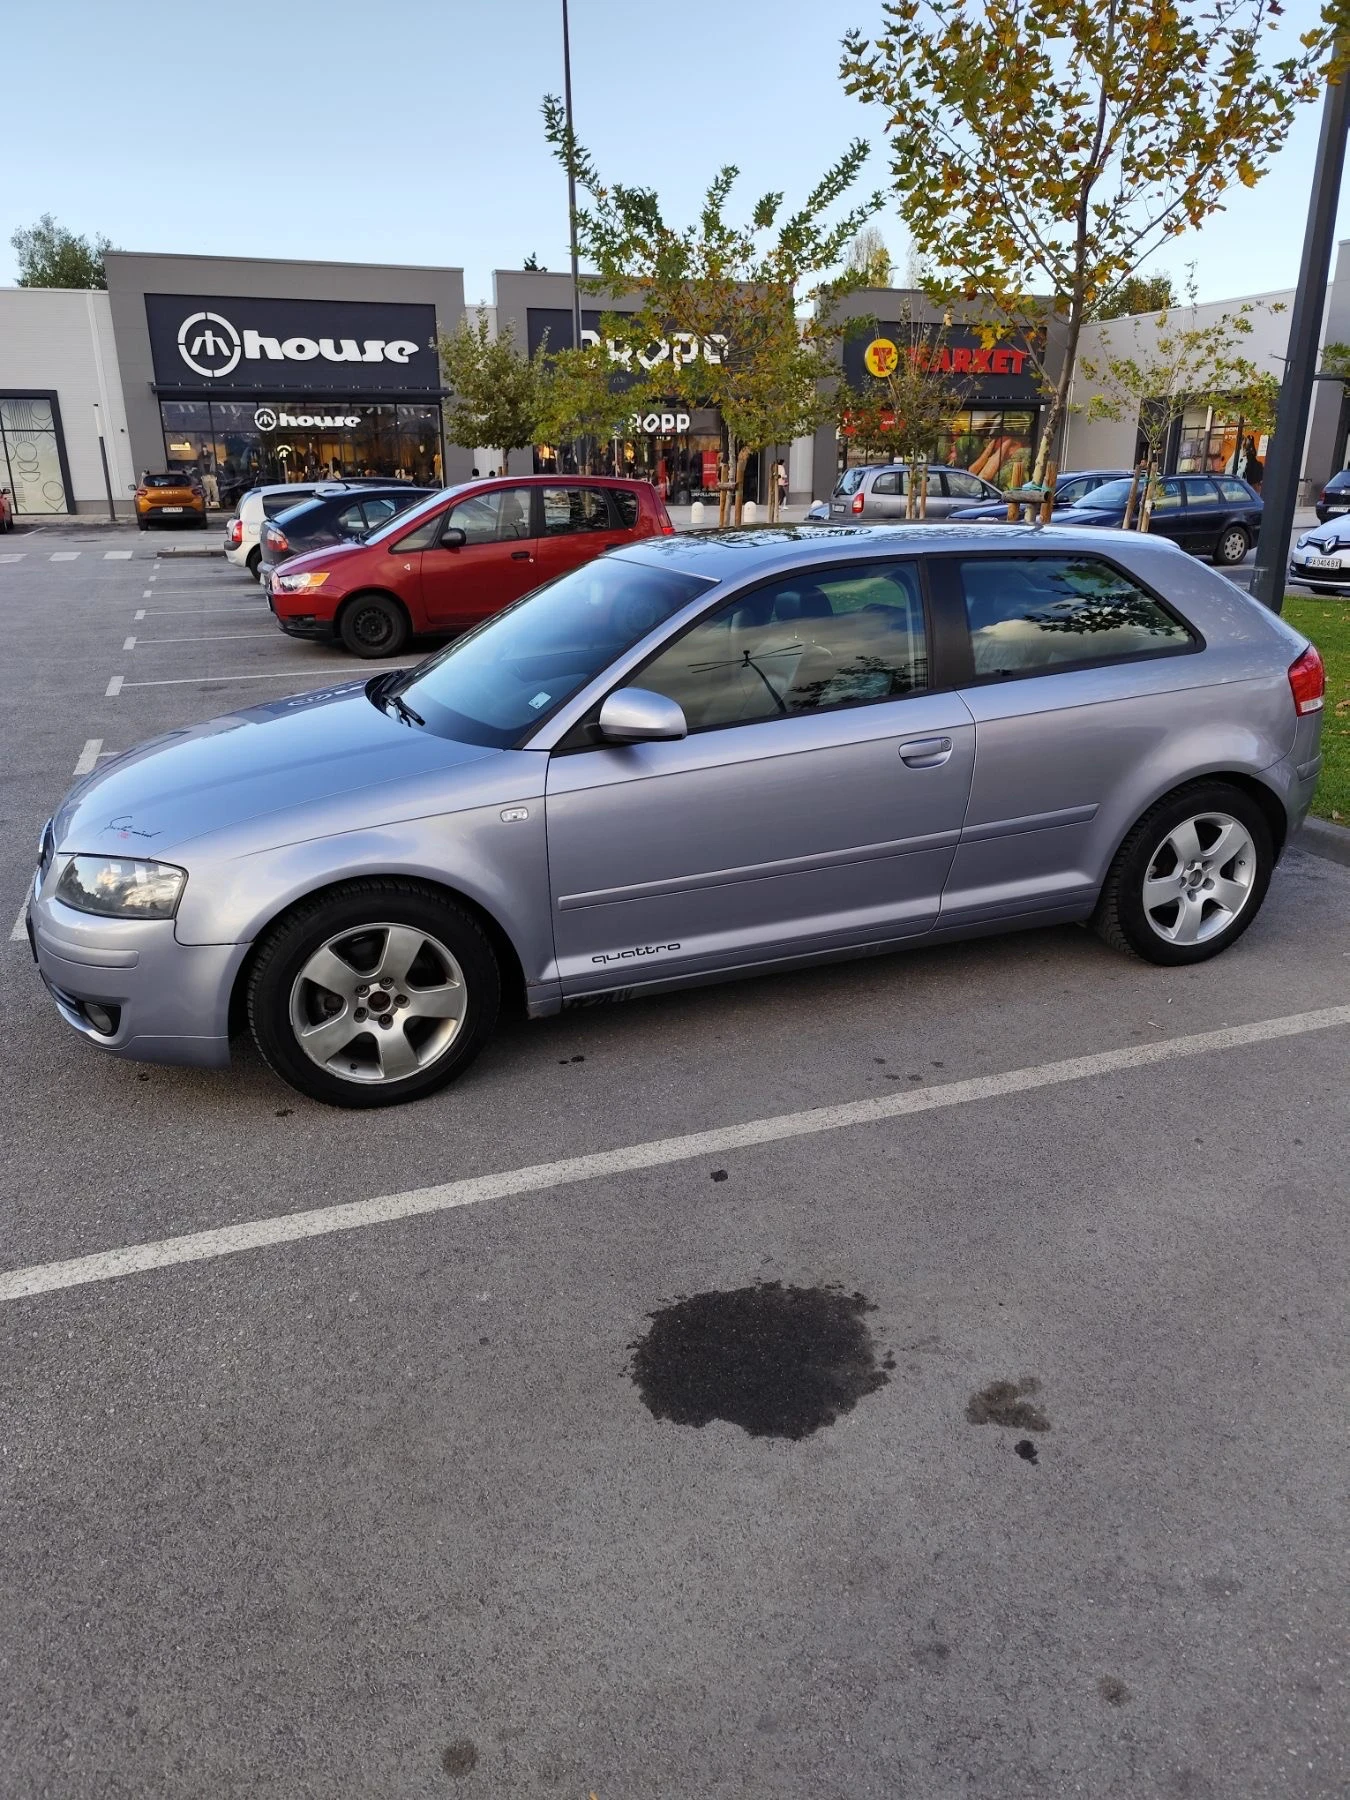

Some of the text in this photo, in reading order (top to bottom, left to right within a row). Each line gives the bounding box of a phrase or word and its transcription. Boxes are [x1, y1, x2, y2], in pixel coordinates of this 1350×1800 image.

[243, 330, 419, 363] house
[873, 348, 892, 371] T
[280, 413, 361, 428] house
[592, 943, 681, 964] quattro
